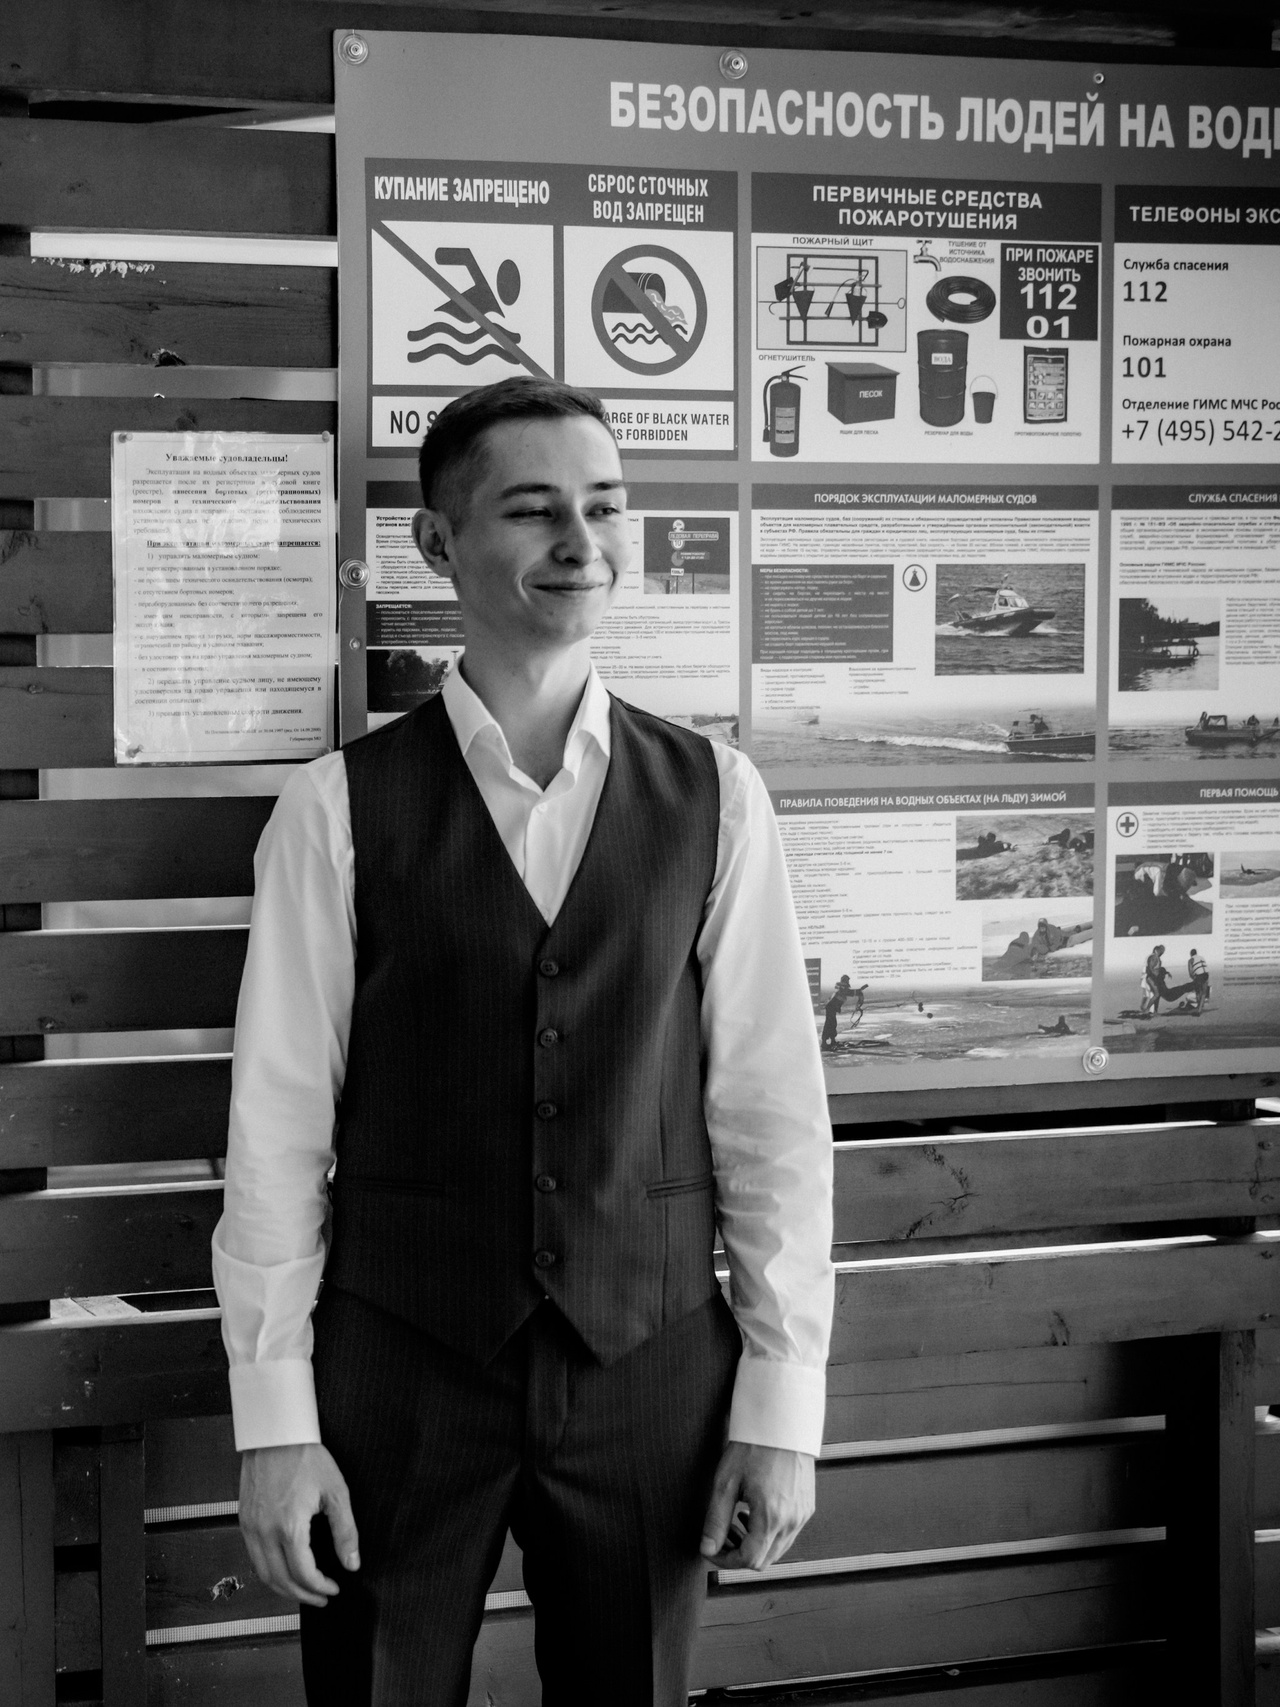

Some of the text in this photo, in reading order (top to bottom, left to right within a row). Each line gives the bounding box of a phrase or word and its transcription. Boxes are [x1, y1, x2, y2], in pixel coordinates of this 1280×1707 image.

[610, 81, 945, 140] БЕЗОПАСНОСТЬ
[956, 92, 1105, 154] ЛЮДЕЙ
[1120, 102, 1176, 148] НА
[374, 176, 550, 207] КУПАНИЕ ЗАПРЕЩЕНО
[588, 174, 708, 197] СБРОС СТОЧНЫХ
[813, 185, 1043, 210] ПЕРВИЧНЫЕ СРЕДСТВА
[593, 200, 704, 225] ВОД ЗАПРЕЩЕН
[839, 208, 1018, 230] ПОЖАРОТУШЕНИЯ
[1130, 205, 1240, 224] ТЕЛЕФОНЫ
[792, 236, 874, 247] ПОЖАРНЫЙ ЩИТ
[1006, 247, 1094, 265] ПРИ ПОЖАРЕ
[1123, 258, 1229, 272] Служба спасения
[1018, 267, 1081, 283] ЗВОНИТЬ
[1020, 283, 1077, 310] 112
[1123, 281, 1168, 302] 112
[1026, 315, 1070, 339] 01
[1123, 335, 1232, 349] Пожарная охрана
[758, 354, 816, 363] ОГНЕТУШИТЕЛЬ
[1122, 356, 1167, 378] 101
[859, 389, 883, 399] ПЕСОК
[1122, 399, 1190, 412] Отделение
[1193, 400, 1228, 411] ГИМС
[1231, 399, 1258, 411] МЧС
[390, 410, 420, 434] NO
[637, 412, 650, 424] OF
[653, 413, 688, 425] BLACK
[690, 413, 730, 426] WATER
[626, 429, 688, 441] FORBIDDEN
[1122, 420, 1149, 441] +7
[1157, 419, 1215, 446] (495)
[218, 453, 288, 463] судовладельцы!
[814, 493, 1037, 505] ПОРЯДОК ЭКСПЛУАТАЦИИ МАЛОМЕРНЫХ СУДОВ
[1188, 493, 1278, 503] СЛУЖБА СПАСЕНИЯ
[780, 790, 1067, 808] ПРАВИЛА ПОВЕДЕНИЯ НА ВОДНЫХ ОБЪЕКТАХ (НА ЛЬДУ) ЗИМОЙ
[1200, 787, 1279, 798] ПЕРВАЯ ПОМОЩЬ
